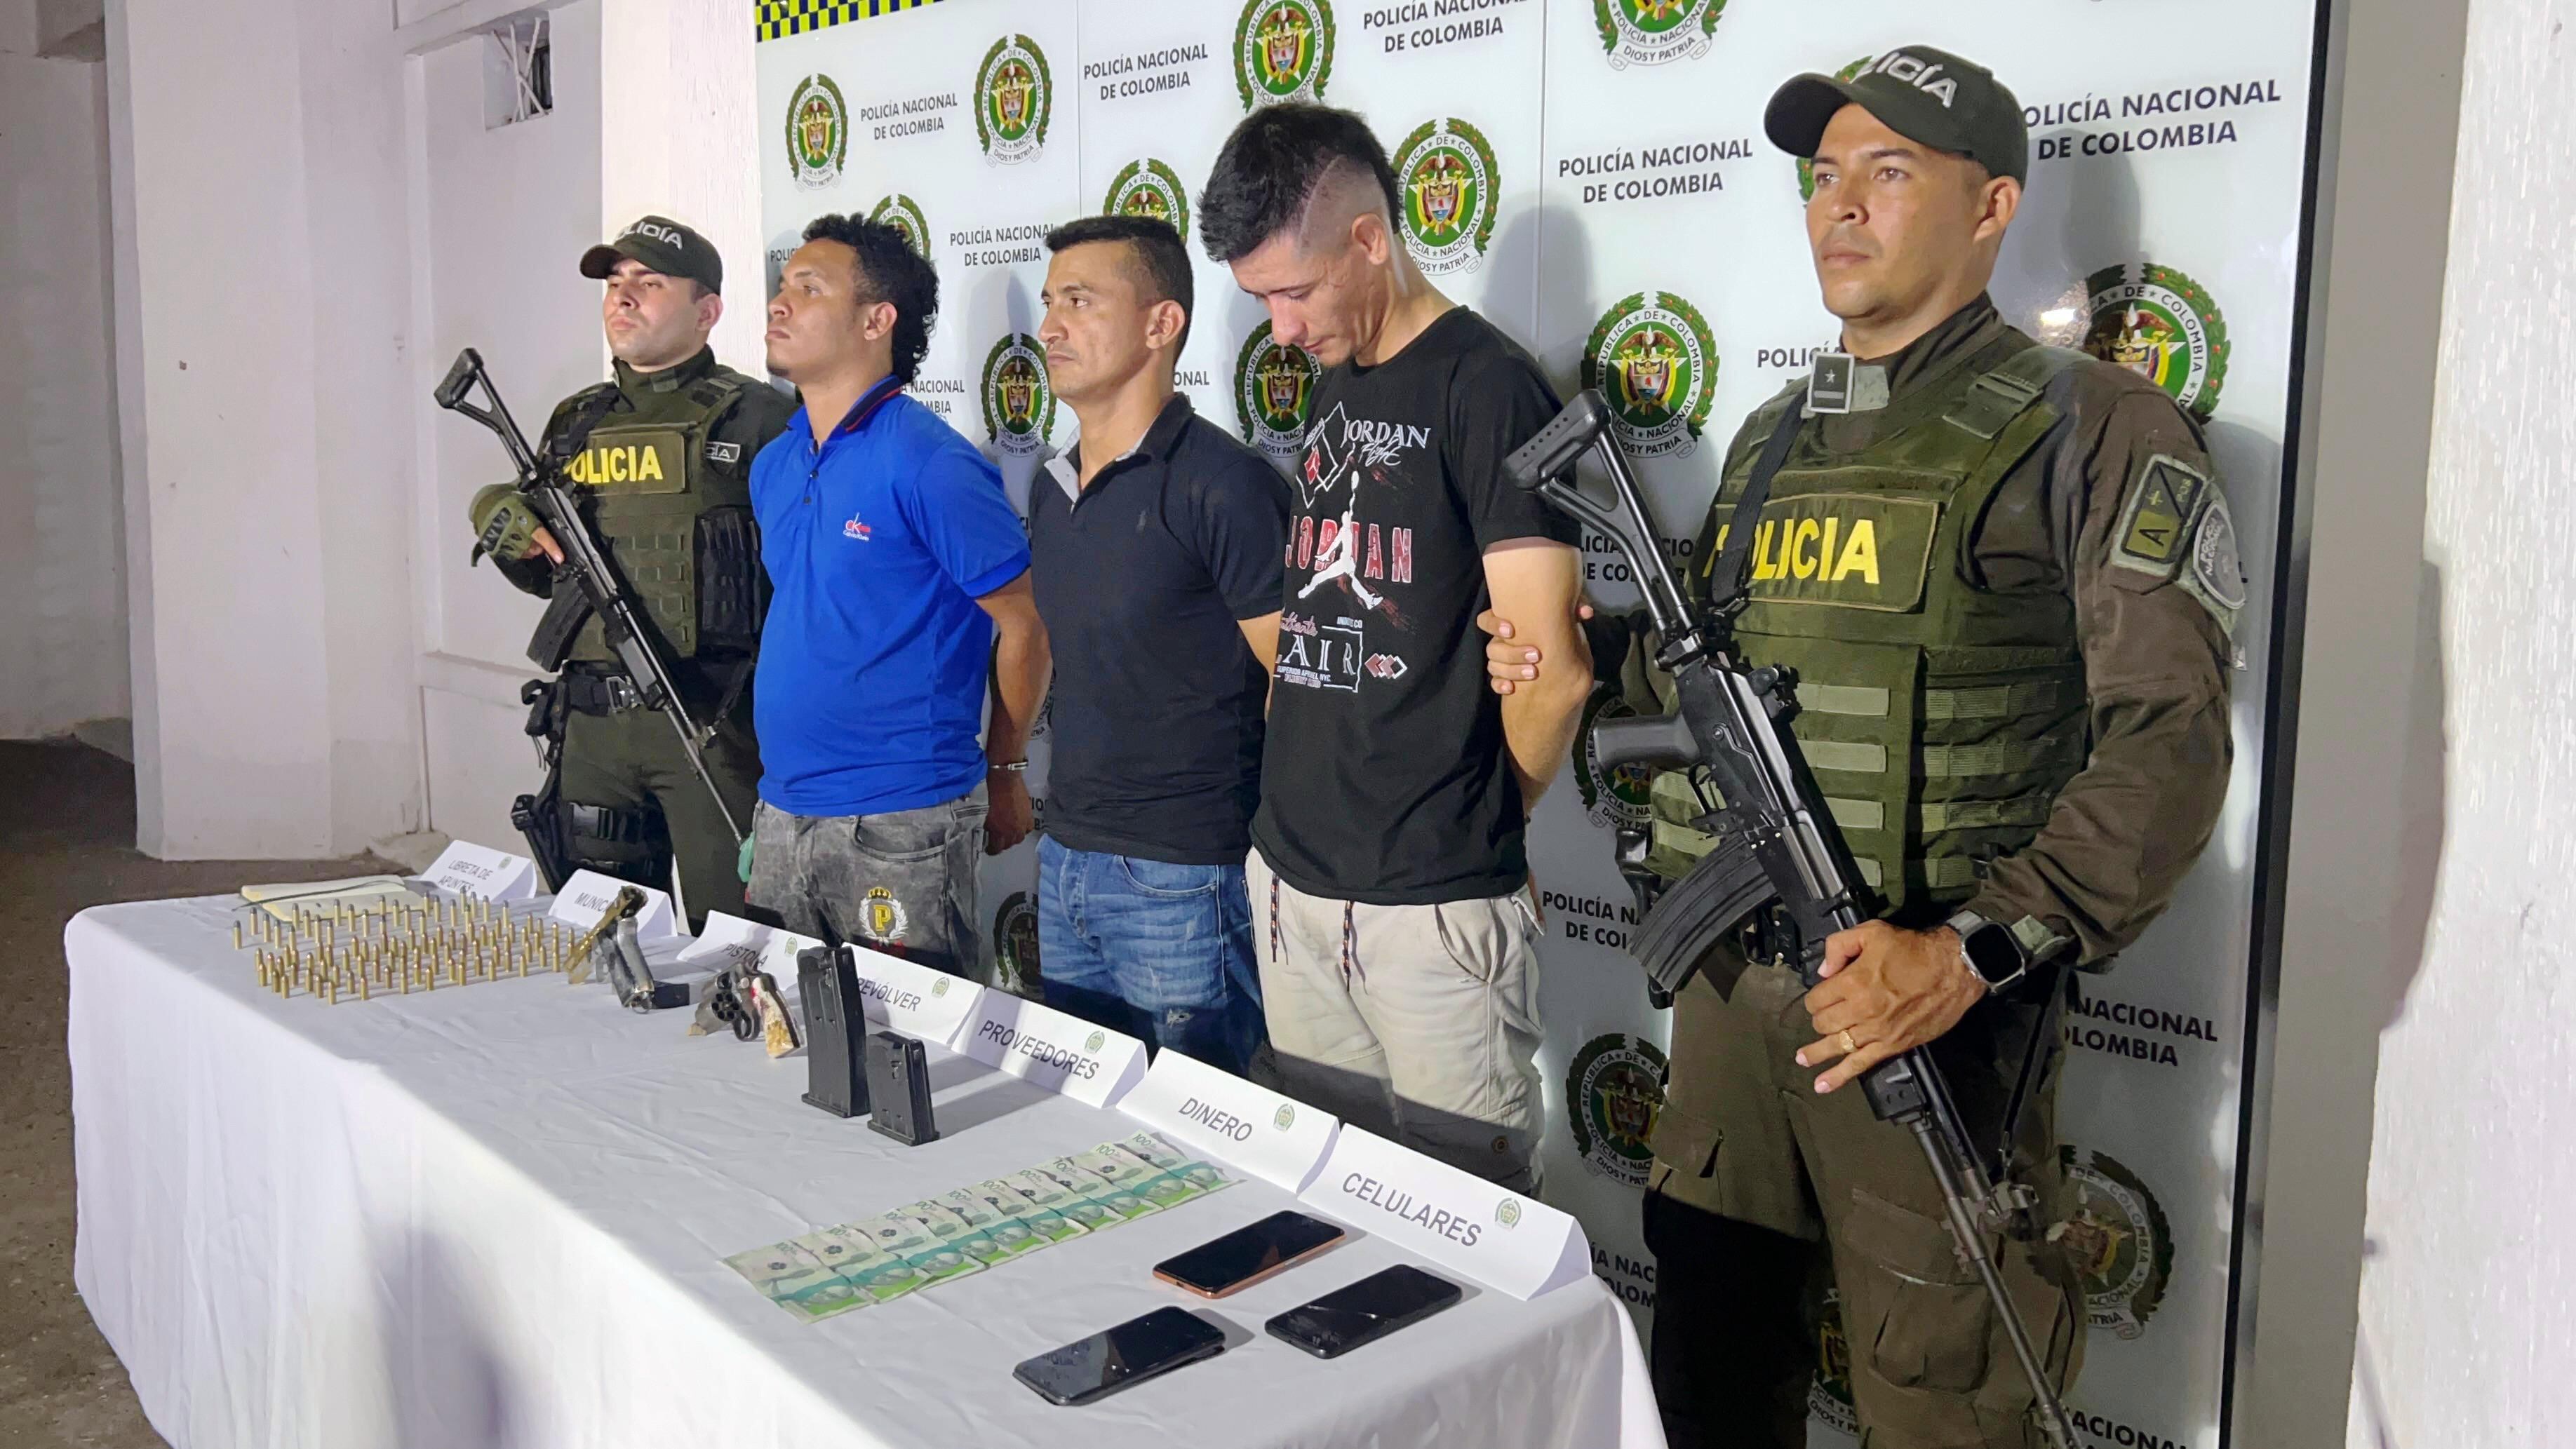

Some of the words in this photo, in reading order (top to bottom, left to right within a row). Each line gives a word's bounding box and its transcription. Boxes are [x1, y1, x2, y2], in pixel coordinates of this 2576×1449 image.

[1298, 0, 1322, 50] OLOMBIA
[1364, 0, 1428, 29] POLICÍA
[1660, 0, 1707, 43] NACIONA
[1385, 34, 1405, 53] DE
[1411, 16, 1503, 48] COLOMBIA
[1659, 36, 1696, 60] PATRIA
[1084, 53, 1133, 80] POLICÍA
[1137, 43, 1208, 70] NACIONAL
[1023, 53, 1042, 103] COLOMBIA
[1100, 84, 1116, 100] DE
[1120, 71, 1190, 97] COLOMBIA
[861, 100, 899, 121] POLICÍA
[903, 93, 958, 114] NACIONAL
[2022, 93, 2112, 128] OLICÍA
[2121, 79, 2281, 118] NACIONAL
[874, 126, 886, 140] DE
[890, 116, 944, 138] COLOMBIA
[1013, 115, 1040, 149] NACIONAL
[2038, 137, 2072, 161] DE
[2081, 121, 2238, 156] COLOMBIA
[1014, 144, 1034, 161] PATRIA
[1559, 147, 1635, 177] POLICÍA
[1642, 138, 1753, 169] NACIONAL
[1436, 136, 1449, 145] DE
[1458, 141, 1485, 202] COLOMBIA
[1157, 179, 1179, 224] COLOMBI
[1583, 183, 1607, 203] DE
[1614, 172, 1724, 201] COLOMBIA
[950, 226, 993, 246] POLICÍA
[1440, 217, 1481, 257] NACIONAL
[965, 252, 978, 267] DE
[981, 247, 1042, 265] COLOMBIA
[1440, 252, 1470, 271] PATRIA
[2124, 285, 2146, 297] DE
[2161, 294, 2203, 372] COLOMBIA
[1597, 318, 1633, 386] REPUBLICA
[1644, 310, 1659, 320] DE
[1670, 317, 1700, 383] COLOMBIA
[1173, 370, 1210, 386] ONAL
[1247, 338, 1270, 396] REPUBLICA
[911, 379, 965, 393] NACIONAL
[1340, 419, 1431, 449] JORDAN
[1646, 398, 1696, 438] NACIONAL
[1646, 435, 1682, 454] PATRIA
[873, 904, 891, 931] P
[1543, 891, 1614, 921] POLICÍA
[1566, 921, 1588, 941] DE
[2074, 997, 2218, 1042] NACIONAL
[979, 1019, 1101, 1081] PROVEEDORES
[1625, 1052, 1639, 1063] DE
[2065, 1025, 2178, 1067] LOMBIA
[1178, 1096, 1254, 1143] DINERO
[1095, 1144, 1115, 1156] 100
[1133, 1133, 1152, 1146] 100
[1341, 1171, 1482, 1248] CELULARES
[2088, 1277, 2142, 1306] ACIONAL
